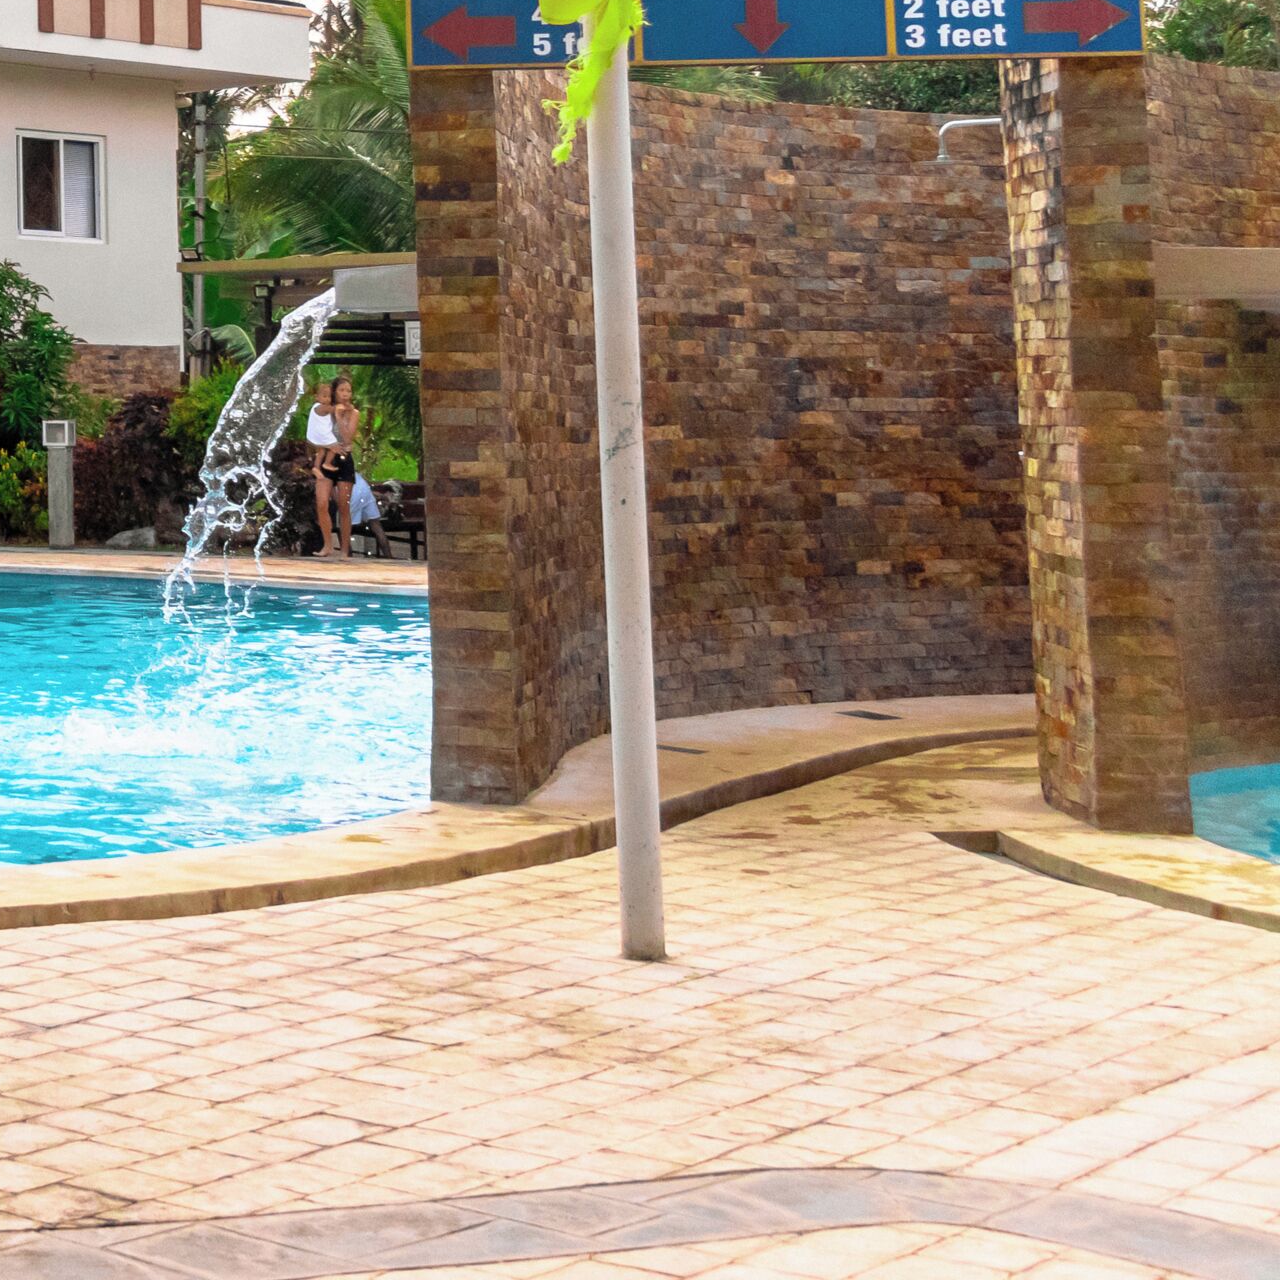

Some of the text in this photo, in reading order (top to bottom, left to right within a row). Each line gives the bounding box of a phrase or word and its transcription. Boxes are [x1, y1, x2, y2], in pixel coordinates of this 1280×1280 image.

[532, 33, 552, 56] 5
[905, 23, 1007, 48] 3 feet
